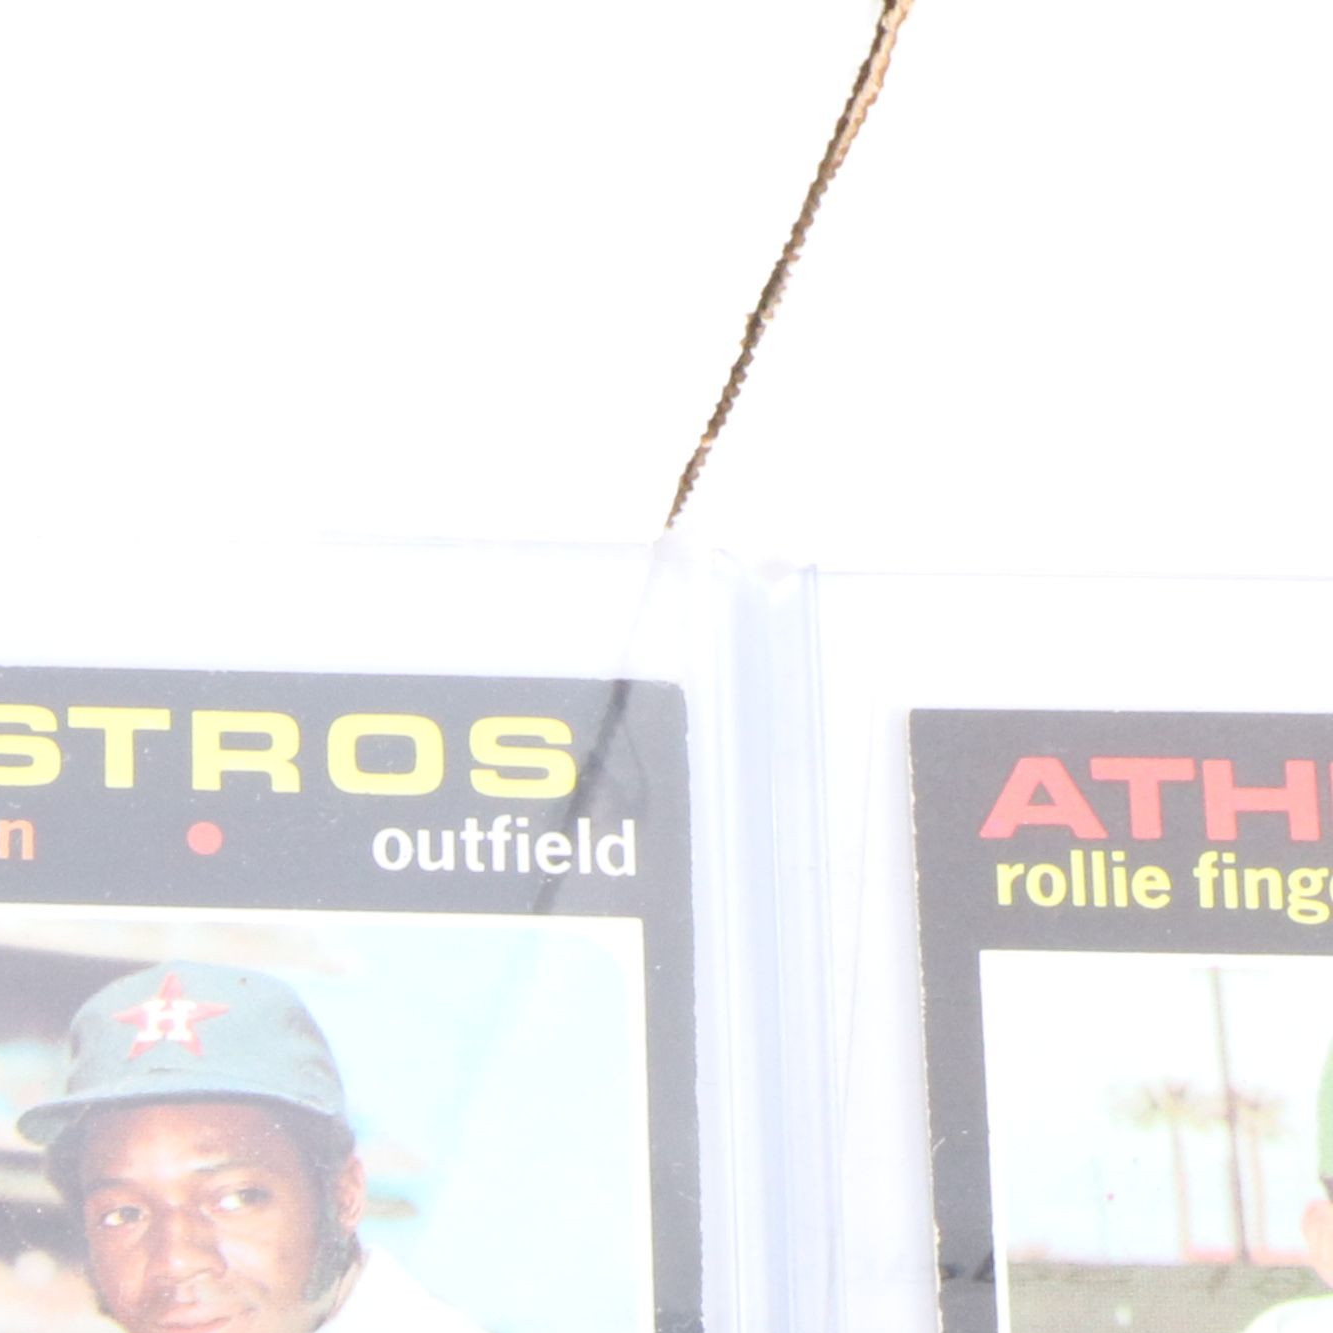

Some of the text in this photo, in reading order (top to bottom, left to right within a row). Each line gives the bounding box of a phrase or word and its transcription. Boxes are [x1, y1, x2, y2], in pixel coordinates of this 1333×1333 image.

[980, 756, 1333, 841] ATH
[372, 817, 636, 876] outfield
[997, 850, 1333, 924] rollie fing
